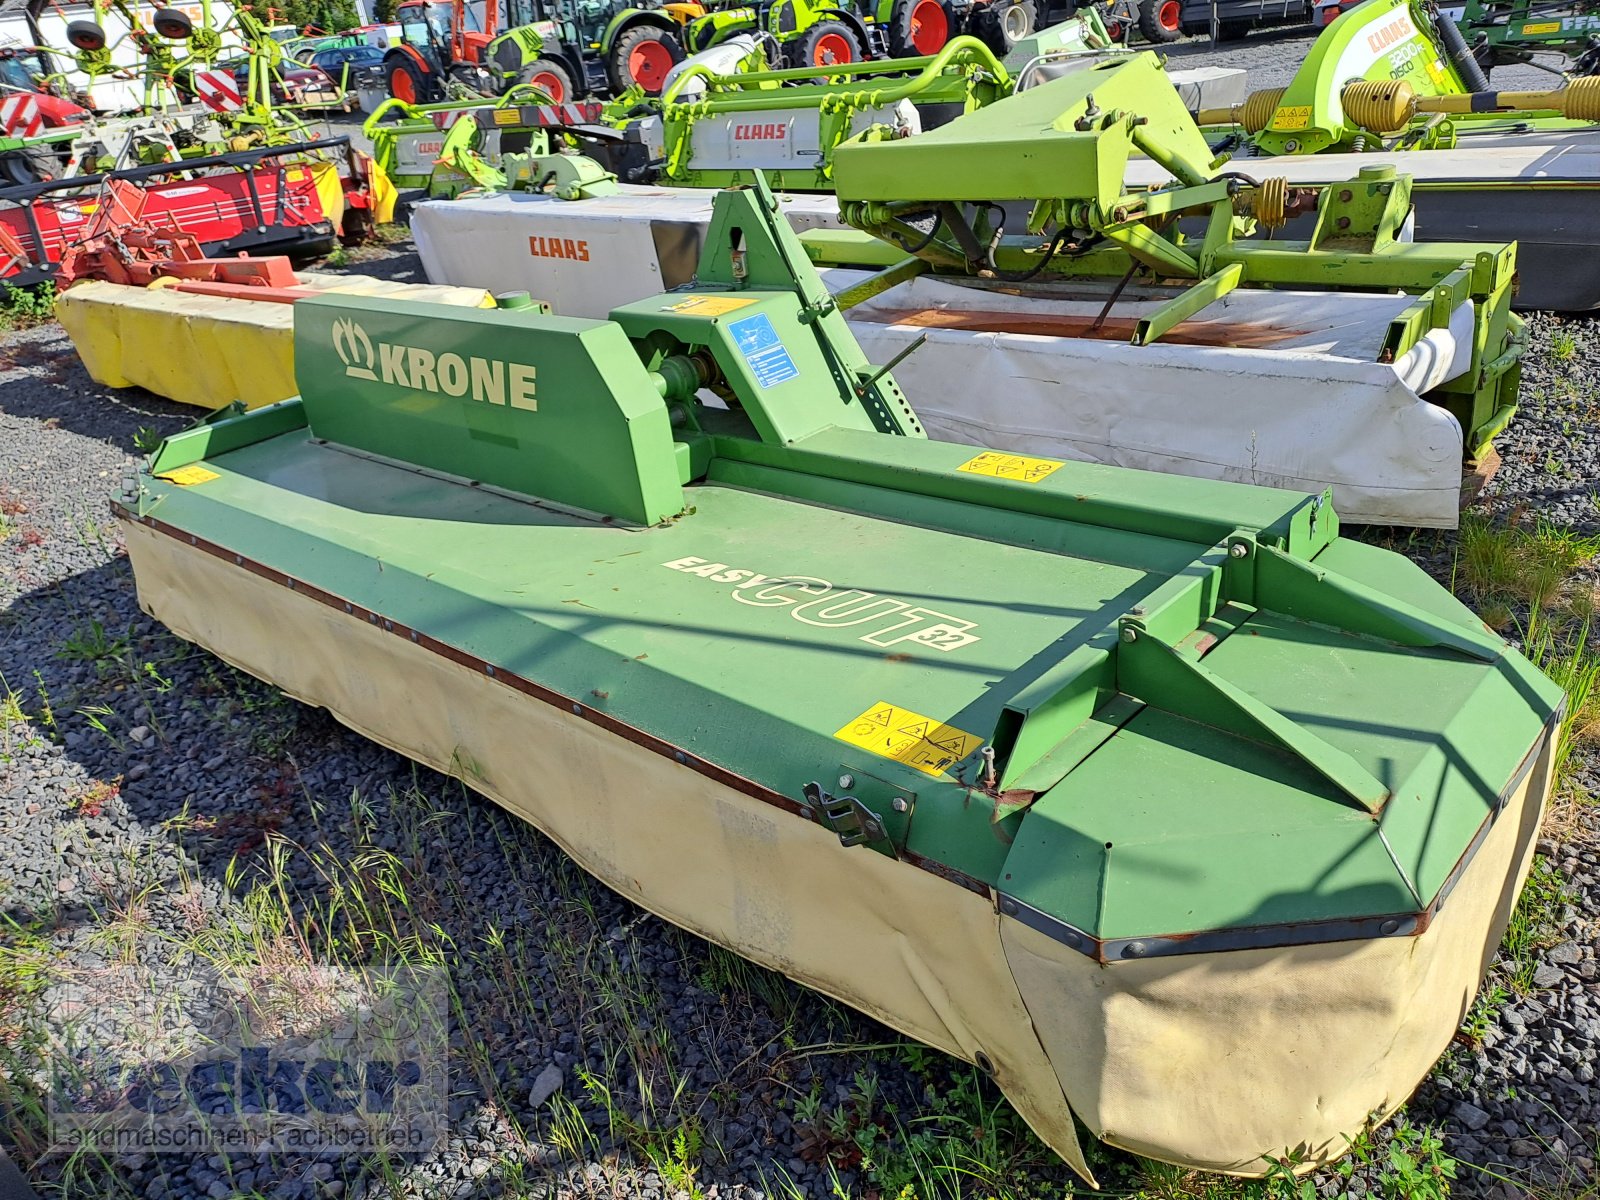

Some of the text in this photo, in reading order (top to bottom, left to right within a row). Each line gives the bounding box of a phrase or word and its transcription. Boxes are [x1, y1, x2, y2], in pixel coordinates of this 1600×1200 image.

[1367, 17, 1411, 54] CLAAS
[1388, 42, 1417, 67] 3200
[1389, 60, 1414, 80] DISCO
[735, 123, 786, 140] CLAAS
[419, 142, 443, 154] CLAA
[529, 236, 590, 262] CLAAS
[378, 343, 538, 412] KRONE
[918, 629, 965, 648] 32
